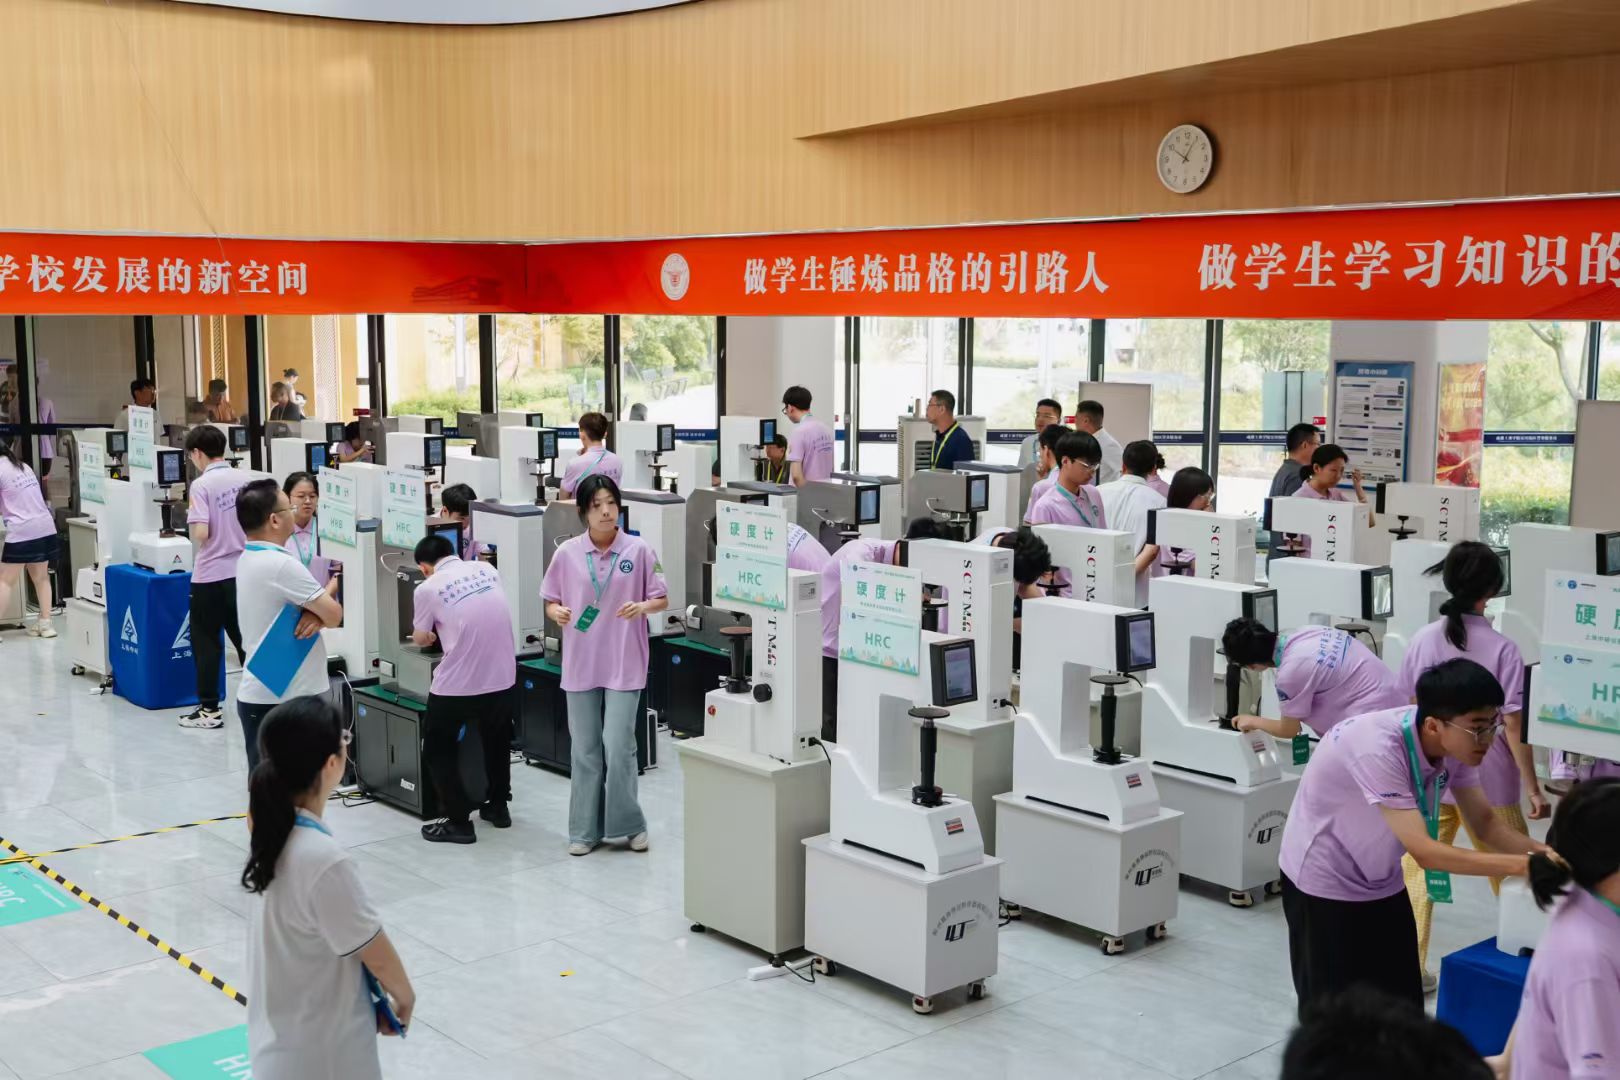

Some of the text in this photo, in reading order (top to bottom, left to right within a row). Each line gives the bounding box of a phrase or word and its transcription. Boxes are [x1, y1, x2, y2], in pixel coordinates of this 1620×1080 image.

[744, 250, 1110, 295] 做学生锤炼品格的引路人
[1198, 232, 1620, 292] 做学生学习知识的
[730, 521, 774, 541] 硬度计
[738, 570, 763, 586] HRC
[856, 581, 906, 603] 硬度计
[864, 632, 892, 649] HRC
